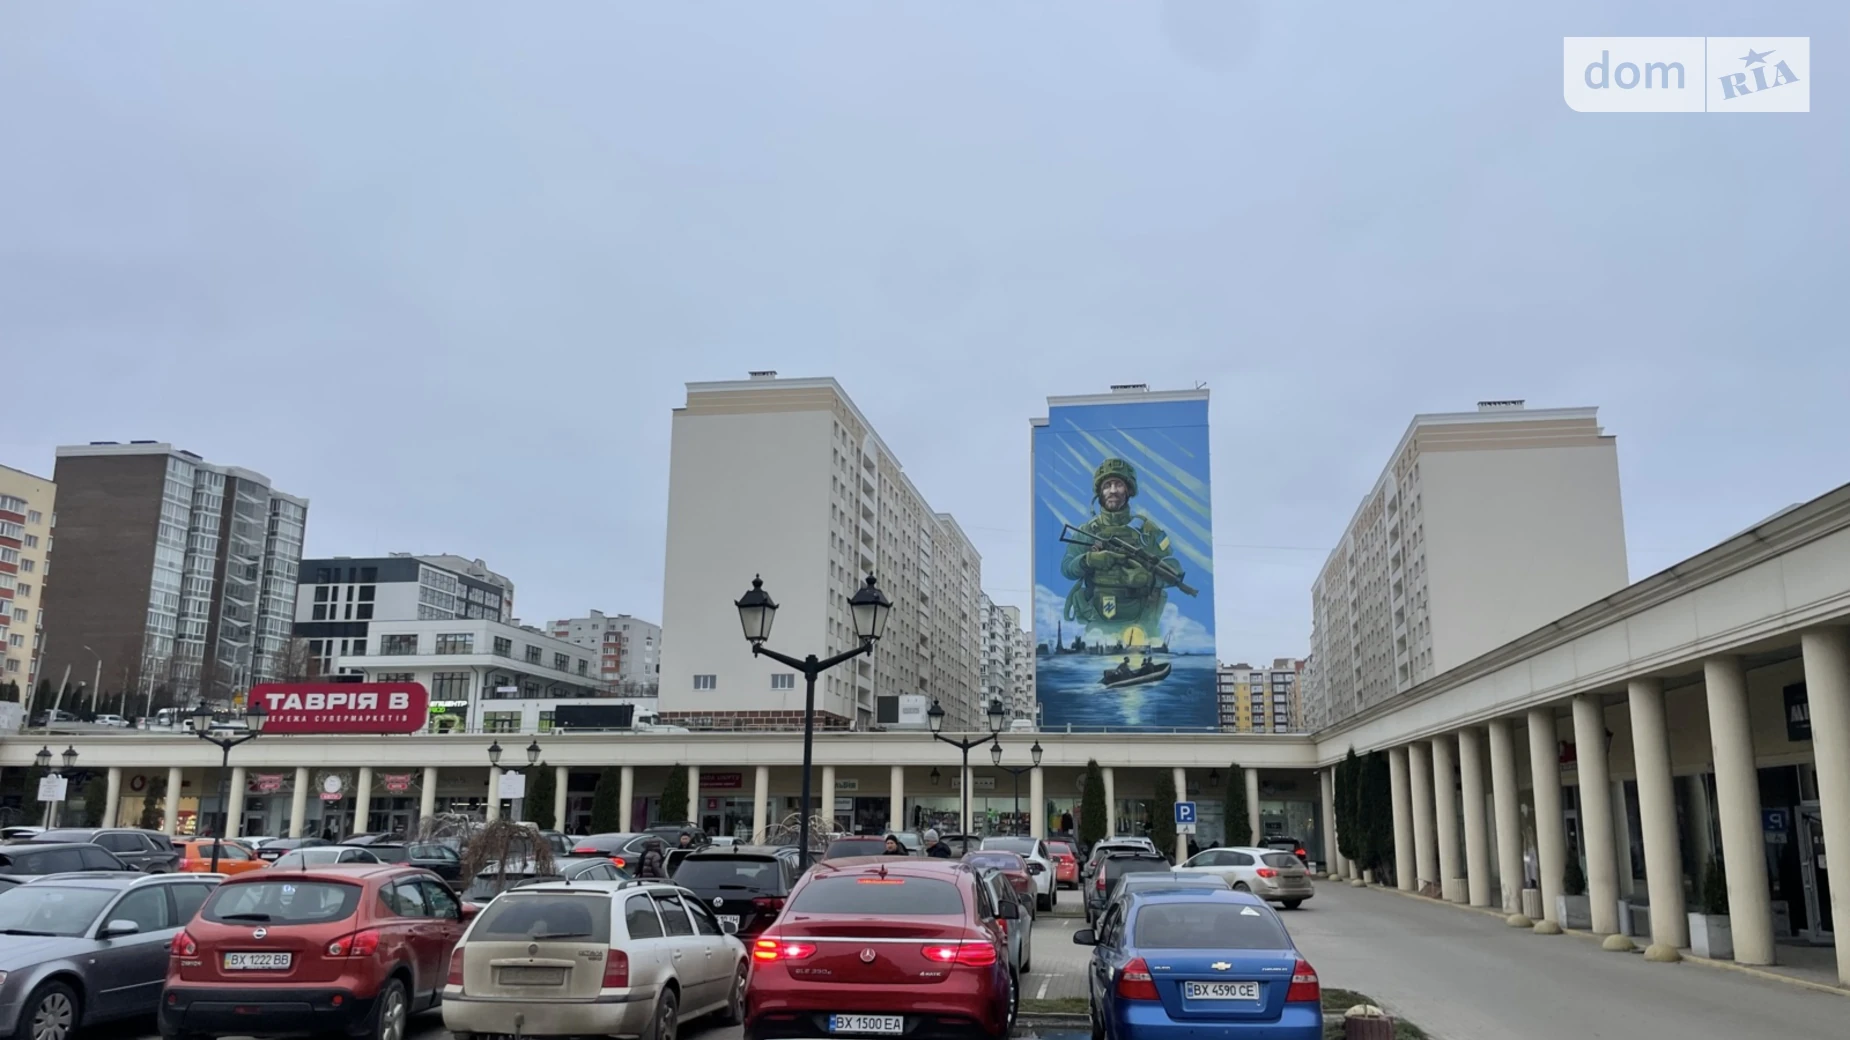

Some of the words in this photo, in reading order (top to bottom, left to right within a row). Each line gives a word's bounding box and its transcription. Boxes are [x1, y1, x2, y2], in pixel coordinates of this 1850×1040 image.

[265, 692, 379, 710] ТАВРІЯ
[388, 692, 410, 710] В
[314, 714, 408, 723] СУПЕРМАРКЕТІВ
[1180, 805, 1190, 820] P
[231, 954, 247, 965] BX
[249, 954, 273, 965] 1222
[273, 954, 289, 965] BB
[1193, 984, 1210, 996] BX
[1212, 984, 1237, 997] 4590
[1238, 984, 1255, 997] CE
[836, 1016, 853, 1030] BX
[857, 1017, 882, 1030] 1500
[884, 1018, 901, 1031] EA
